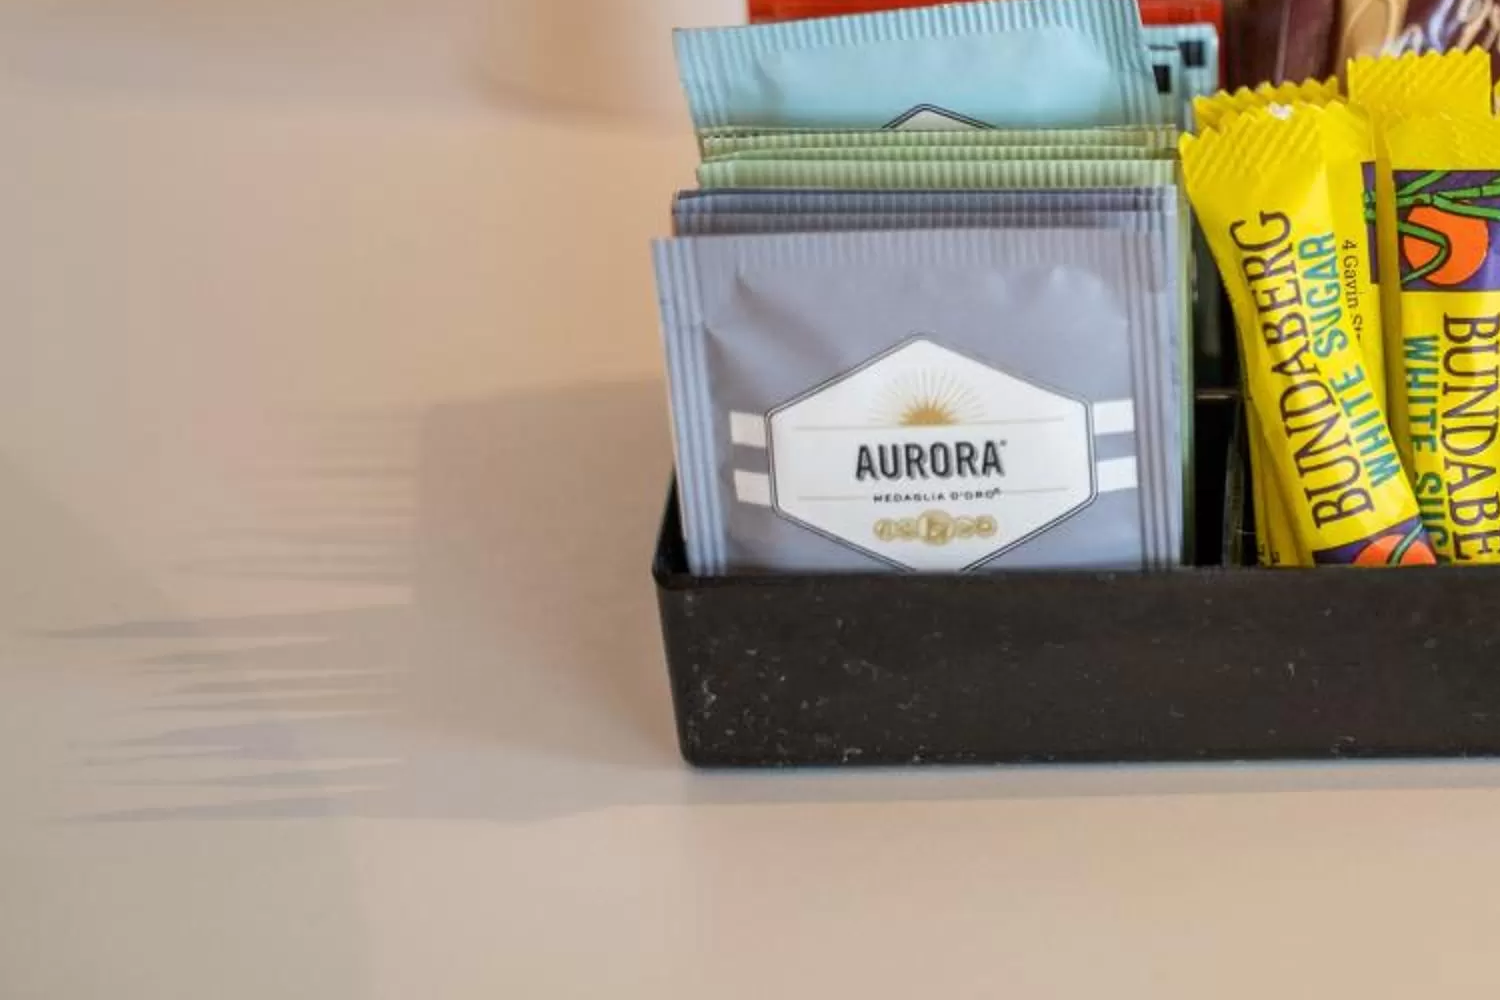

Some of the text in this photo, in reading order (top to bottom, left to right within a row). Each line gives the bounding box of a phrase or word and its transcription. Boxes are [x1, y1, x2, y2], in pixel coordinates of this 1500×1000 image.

[1342, 240, 1359, 251] 4
[1343, 255, 1365, 309] Gavin
[1229, 210, 1374, 529] BUNDABERG
[1296, 231, 1401, 488] WHITE SUGAR
[855, 439, 1005, 482] AURORA
[1402, 334, 1453, 564] WHITE SU
[872, 491, 947, 504] MEDAGLIA
